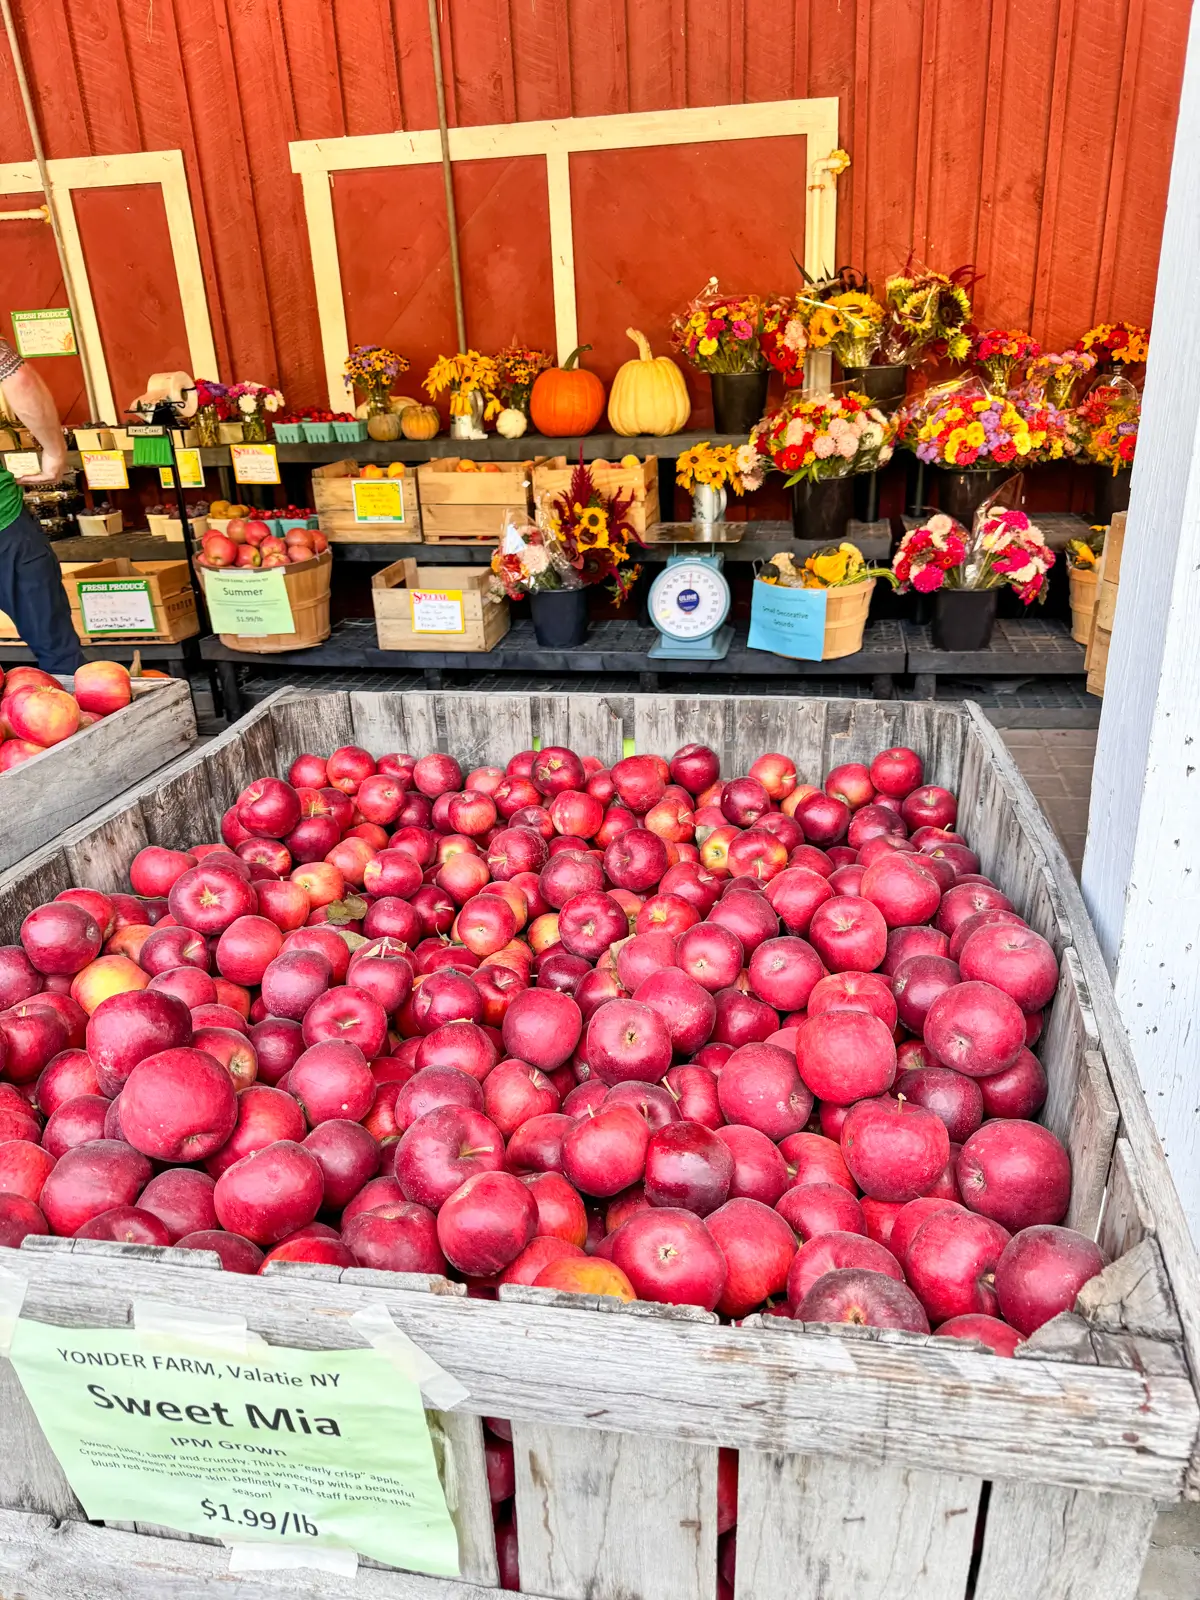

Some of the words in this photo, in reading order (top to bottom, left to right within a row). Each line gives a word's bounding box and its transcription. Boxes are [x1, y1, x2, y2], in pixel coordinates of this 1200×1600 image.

[109, 582, 145, 590] PRODUCE
[223, 587, 263, 596] Summer
[679, 594, 698, 602] ULINE
[762, 606, 775, 614] Small
[777, 609, 809, 619] Decorative
[773, 619, 794, 628] Gourds
[56, 1348, 147, 1369] YONDER
[152, 1356, 222, 1379] FARM,
[226, 1365, 304, 1387] Valatie
[310, 1373, 340, 1388] NY
[87, 1384, 234, 1427] Sweet
[245, 1403, 342, 1437] Mia
[170, 1437, 213, 1449] IPM
[218, 1440, 287, 1457] Grown
[80, 1439, 116, 1451] Sweet,
[117, 1445, 145, 1457] juicy,
[146, 1452, 176, 1460] tangy
[202, 1456, 250, 1466] crunchy.
[370, 1474, 404, 1487] apple.
[79, 1448, 120, 1459] Crossed
[121, 1454, 167, 1467] between
[177, 1463, 238, 1474] honeycrisp
[241, 1468, 261, 1476] and
[273, 1472, 324, 1487] winecrisp
[327, 1480, 353, 1489] with
[364, 1484, 415, 1499] beautiful
[91, 1459, 120, 1468] blush
[142, 1466, 165, 1474] over
[167, 1470, 201, 1479] yellow
[205, 1474, 231, 1482] skin.
[233, 1475, 281, 1488] Definetly
[292, 1484, 315, 1495] Taft
[316, 1491, 341, 1500] staff
[344, 1493, 387, 1503] favorite
[390, 1499, 411, 1507] this
[232, 1487, 272, 1498] season!
[201, 1498, 319, 1537] $1.99/lb
